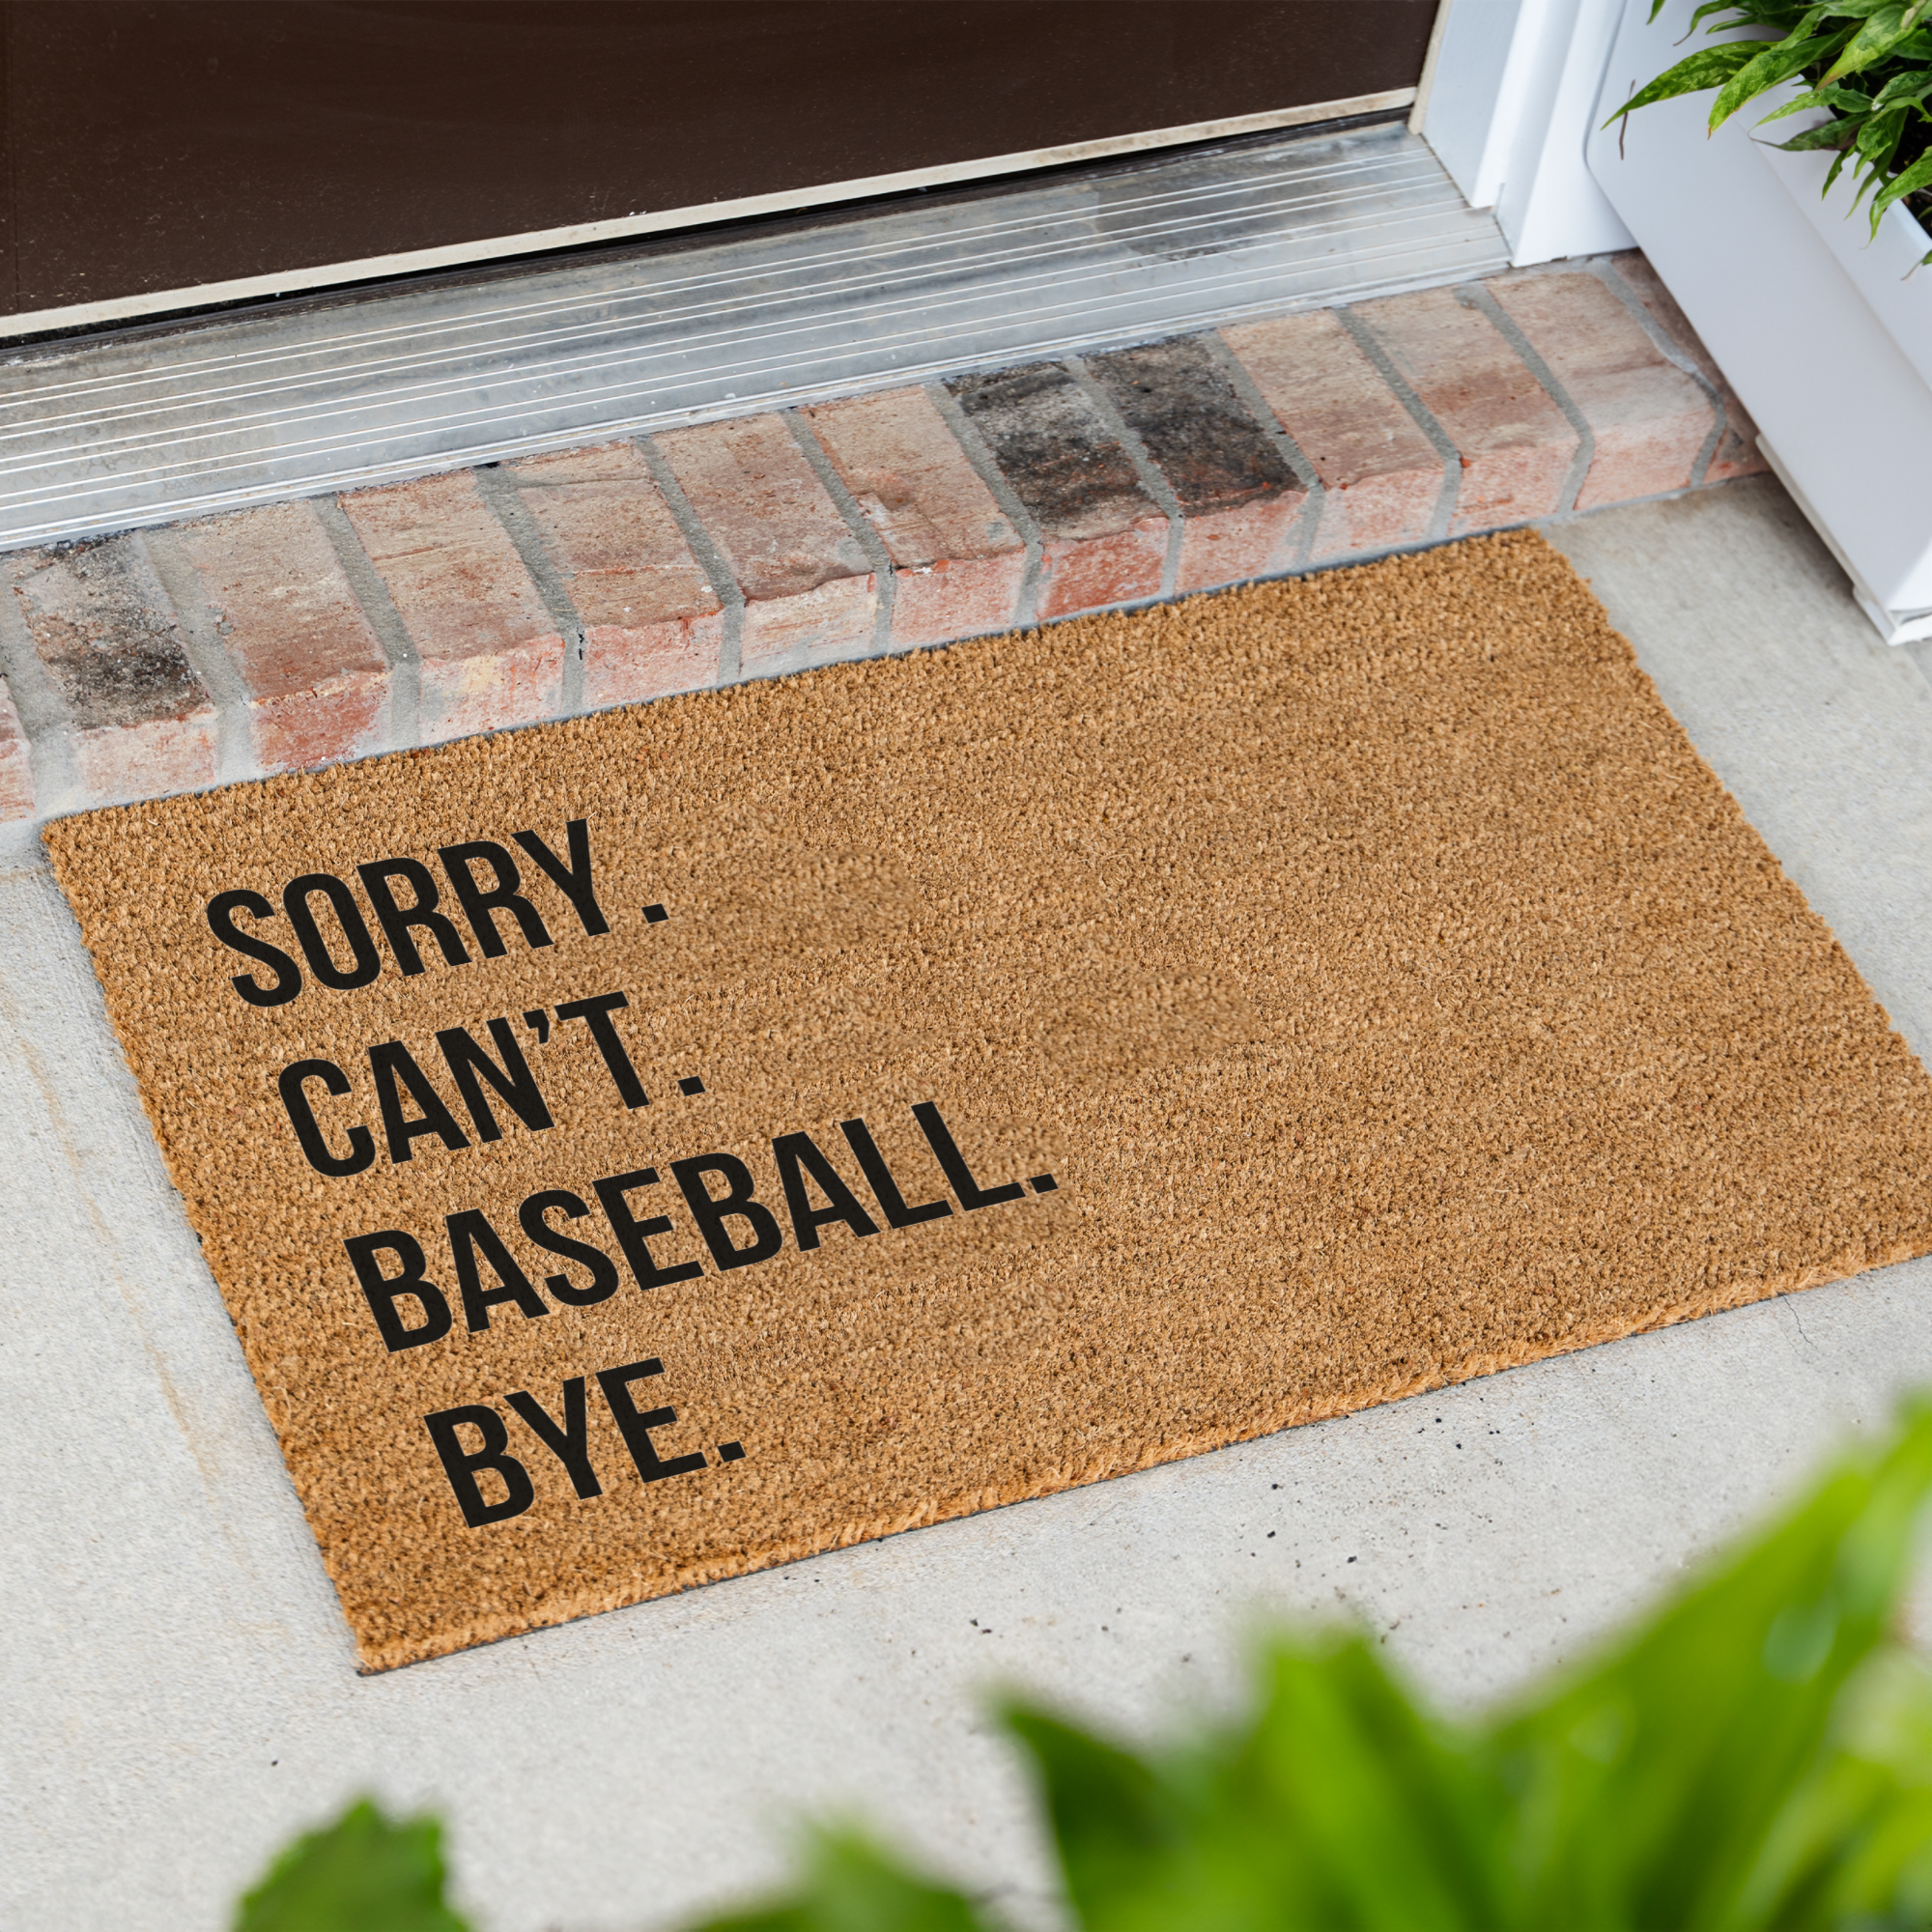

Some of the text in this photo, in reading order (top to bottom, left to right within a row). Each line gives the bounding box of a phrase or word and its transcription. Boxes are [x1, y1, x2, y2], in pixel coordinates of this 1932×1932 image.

[205, 818, 669, 1008] SORRY.
[277, 990, 706, 1178] CAN’T.
[343, 1100, 1059, 1353] BASEBALL.
[423, 1356, 746, 1529] BYE.
